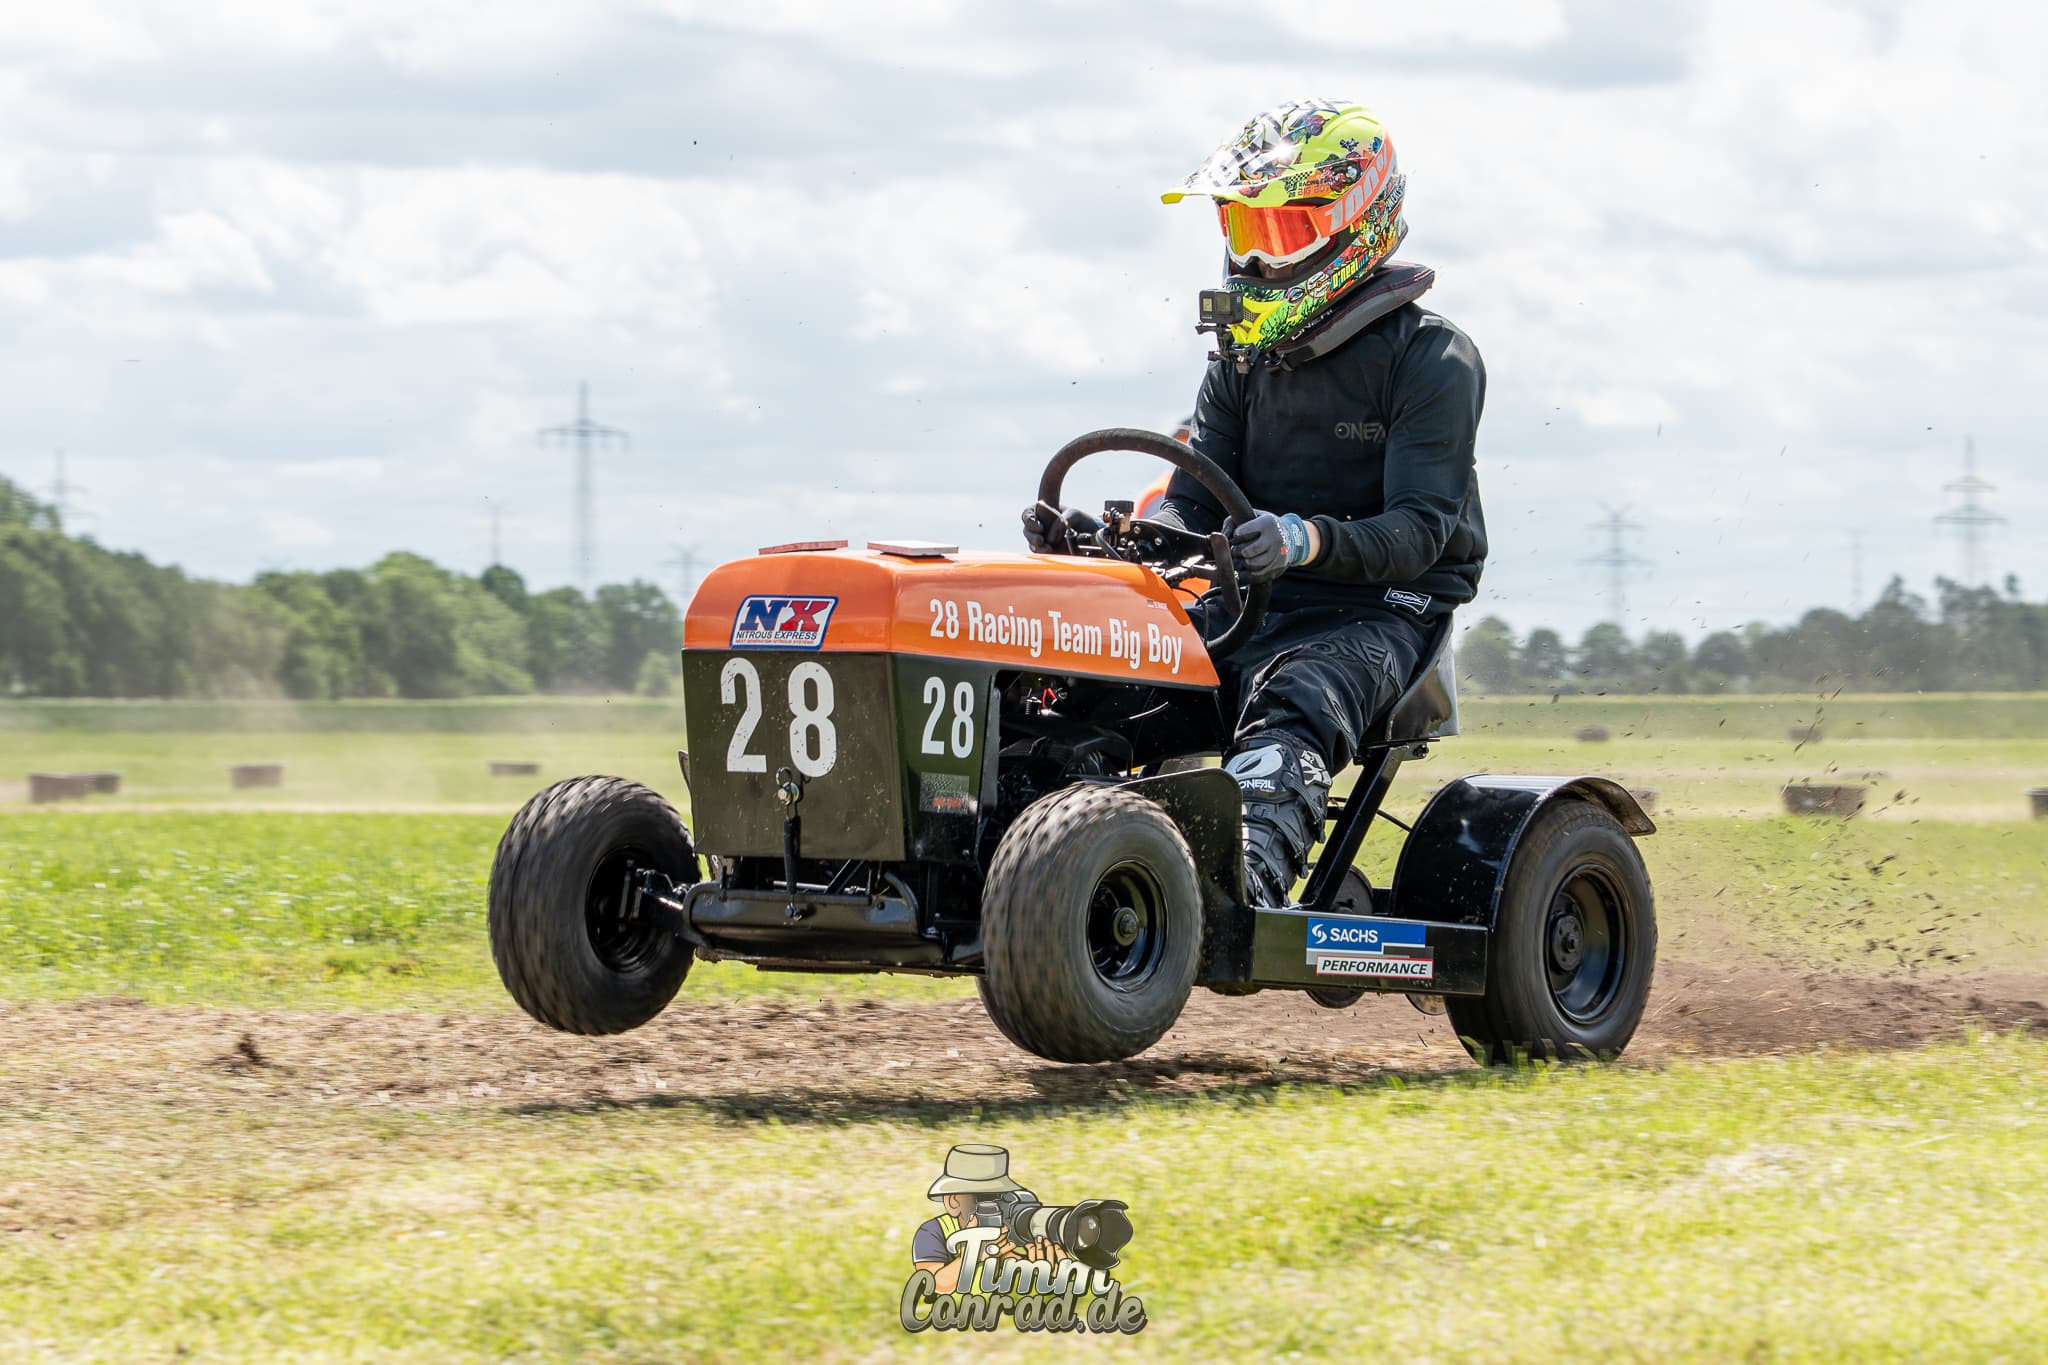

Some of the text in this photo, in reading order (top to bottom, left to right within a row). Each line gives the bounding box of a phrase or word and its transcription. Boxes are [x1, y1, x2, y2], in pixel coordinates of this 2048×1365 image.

[739, 600, 829, 632] NX
[736, 631, 817, 640] NITROUS EXPRESS
[929, 598, 1183, 674] 28 Racing Team Big Boy
[720, 657, 837, 778] 28
[921, 676, 974, 759] 28
[1329, 927, 1379, 944] SACHS
[1321, 959, 1428, 975] PERFORMANCE
